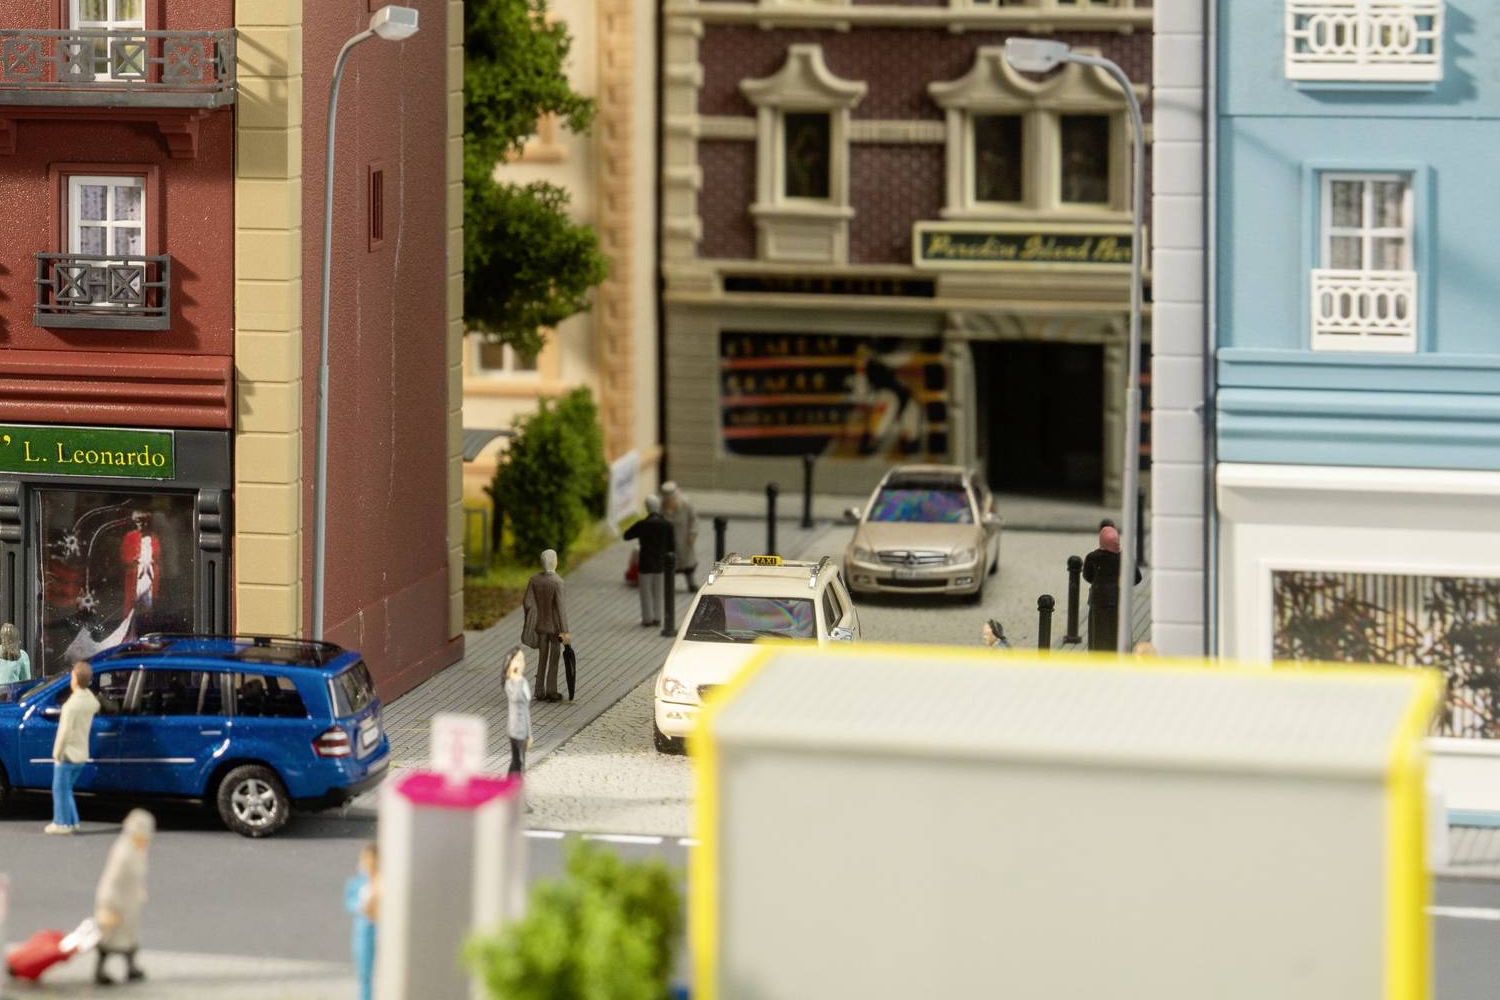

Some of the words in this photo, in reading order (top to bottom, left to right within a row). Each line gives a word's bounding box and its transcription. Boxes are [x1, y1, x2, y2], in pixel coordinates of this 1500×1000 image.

[23, 440, 48, 462] L.
[56, 442, 166, 467] Leonardo
[755, 557, 776, 565] TAXI
